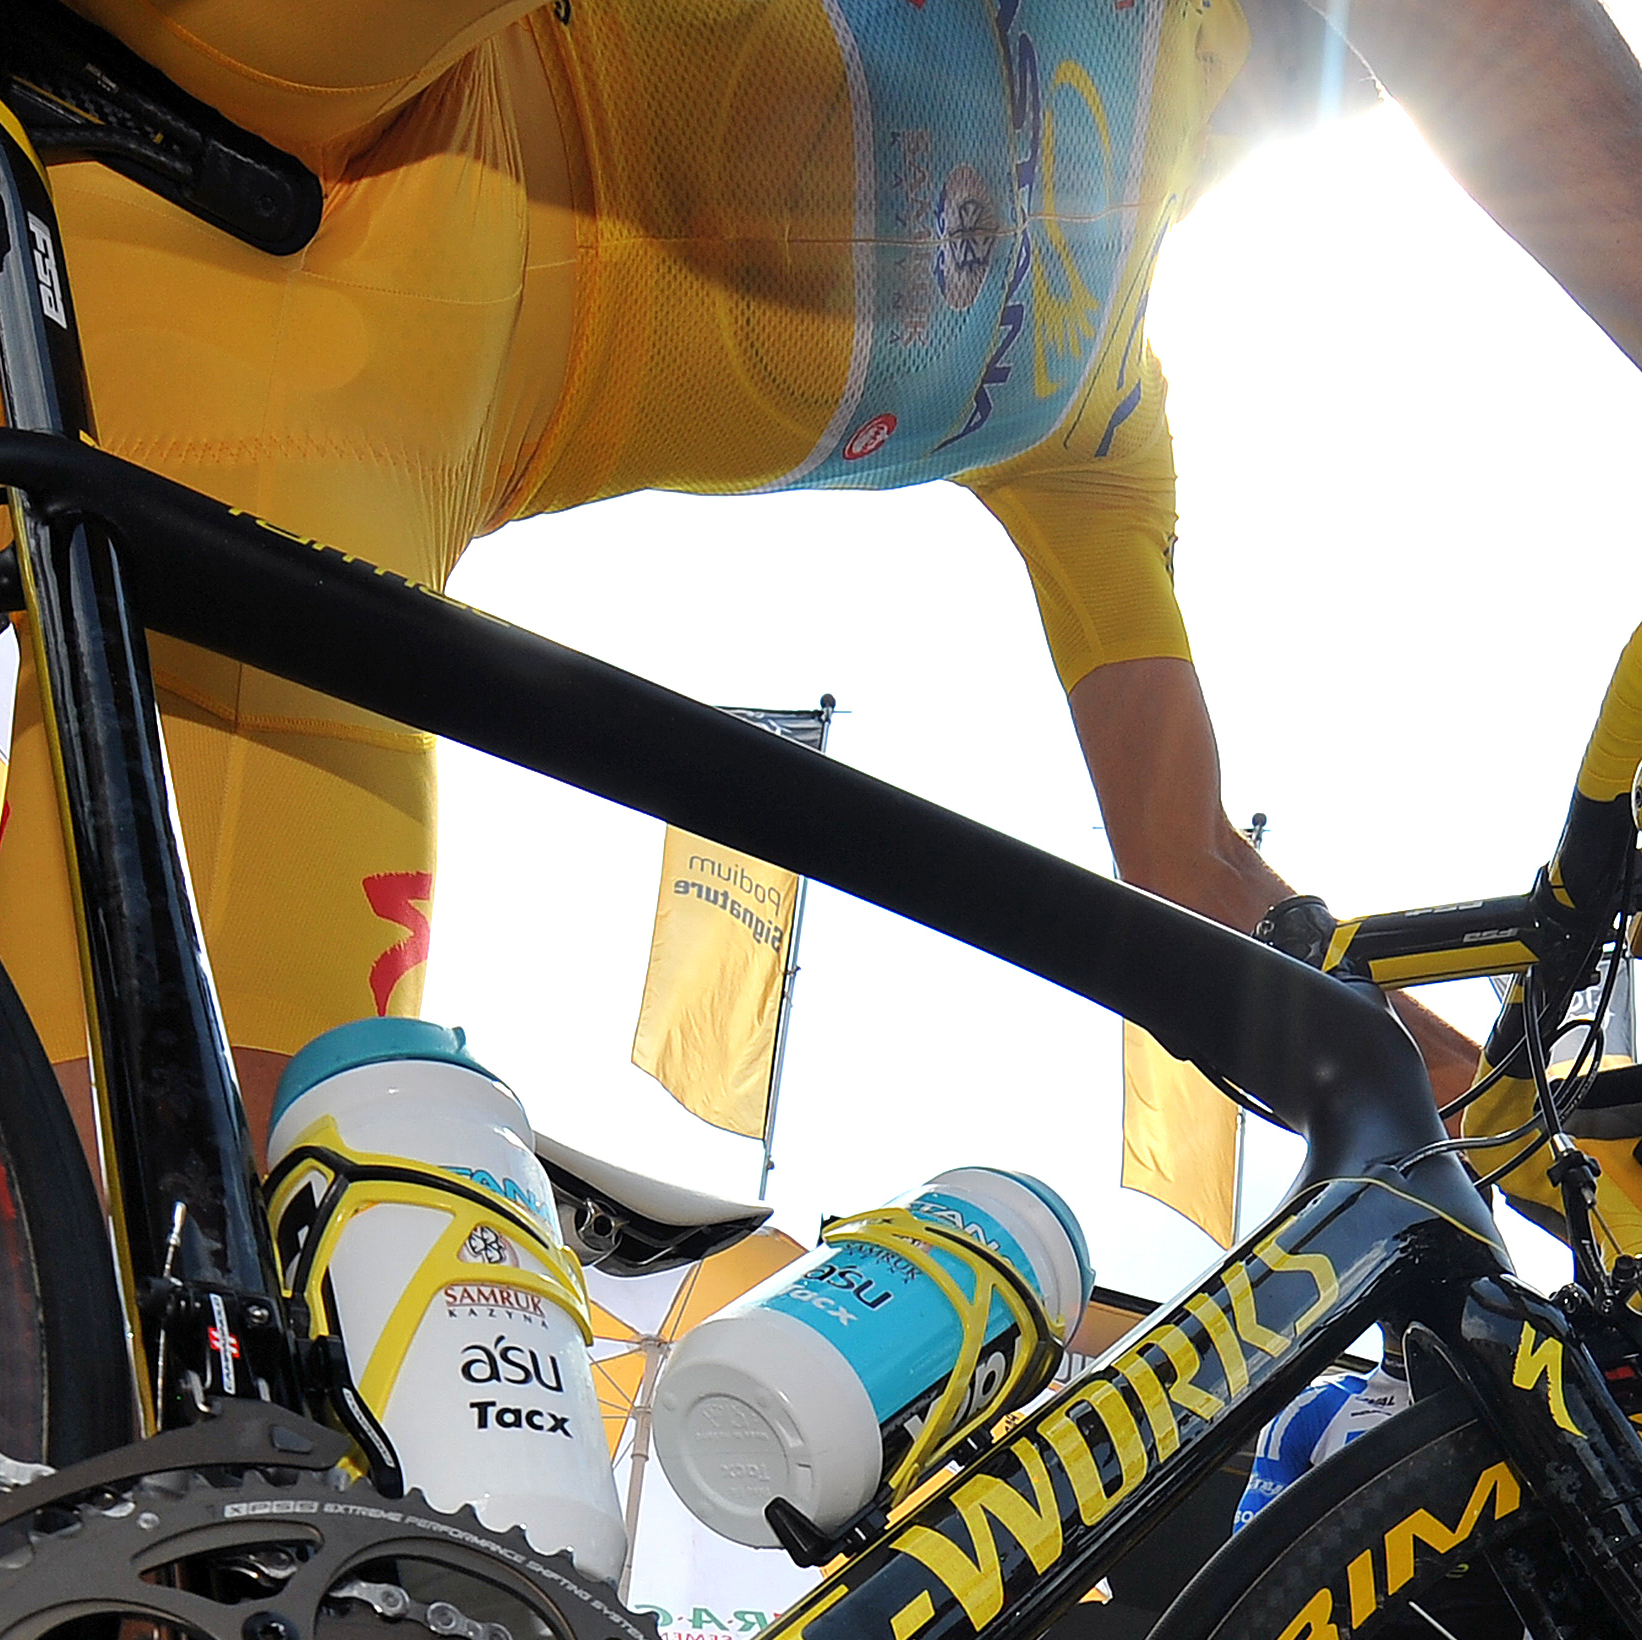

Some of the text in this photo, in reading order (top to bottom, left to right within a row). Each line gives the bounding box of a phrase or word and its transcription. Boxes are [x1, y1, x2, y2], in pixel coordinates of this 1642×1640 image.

[444, 1284, 547, 1319] SAMRUK
[448, 1308, 550, 1331] KAZYNA
[469, 1400, 574, 1439] Tacx
[323, 1502, 401, 1526] EXTREME
